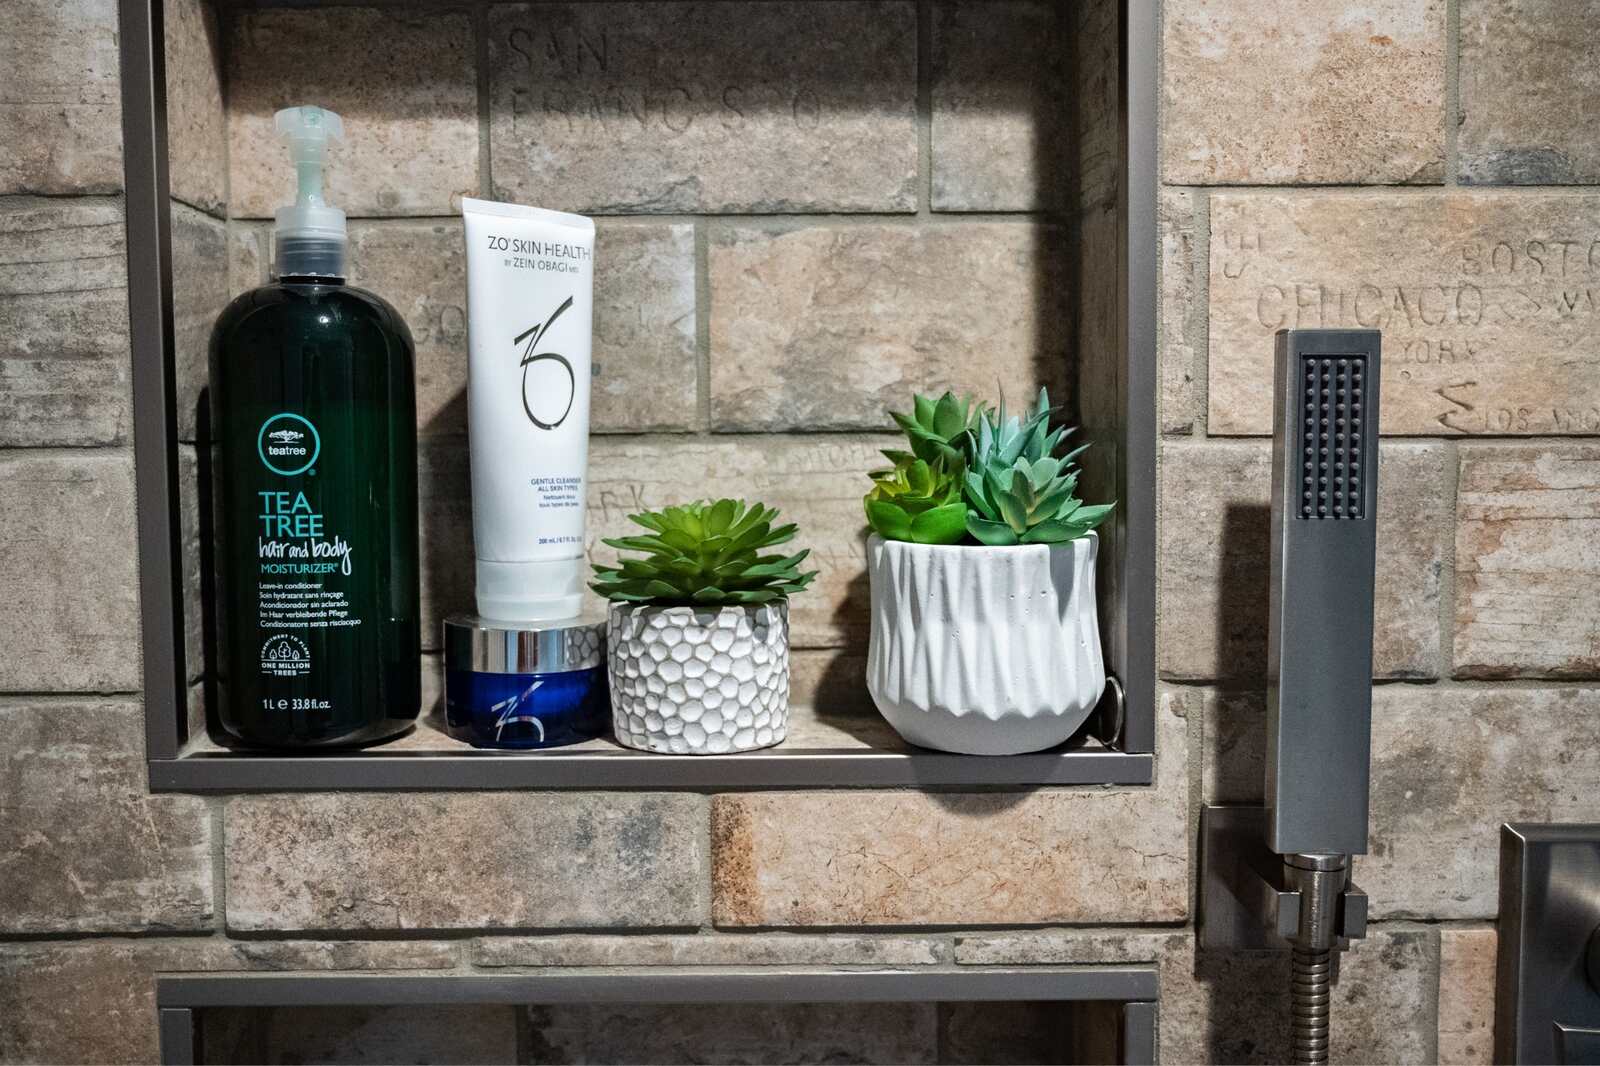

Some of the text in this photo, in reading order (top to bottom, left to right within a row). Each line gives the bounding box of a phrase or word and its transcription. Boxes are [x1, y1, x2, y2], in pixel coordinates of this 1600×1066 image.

[513, 239, 541, 255] SKIN
[545, 242, 591, 260] HEALTH
[513, 257, 535, 269] ZEIN
[537, 260, 568, 272] OBAGI
[268, 445, 306, 456] teatree
[258, 491, 312, 514] TEA
[259, 514, 324, 537] TREE
[258, 535, 352, 576] hair and body
[259, 582, 323, 590] Leave-in conditioner
[292, 699, 310, 710] 33.8
